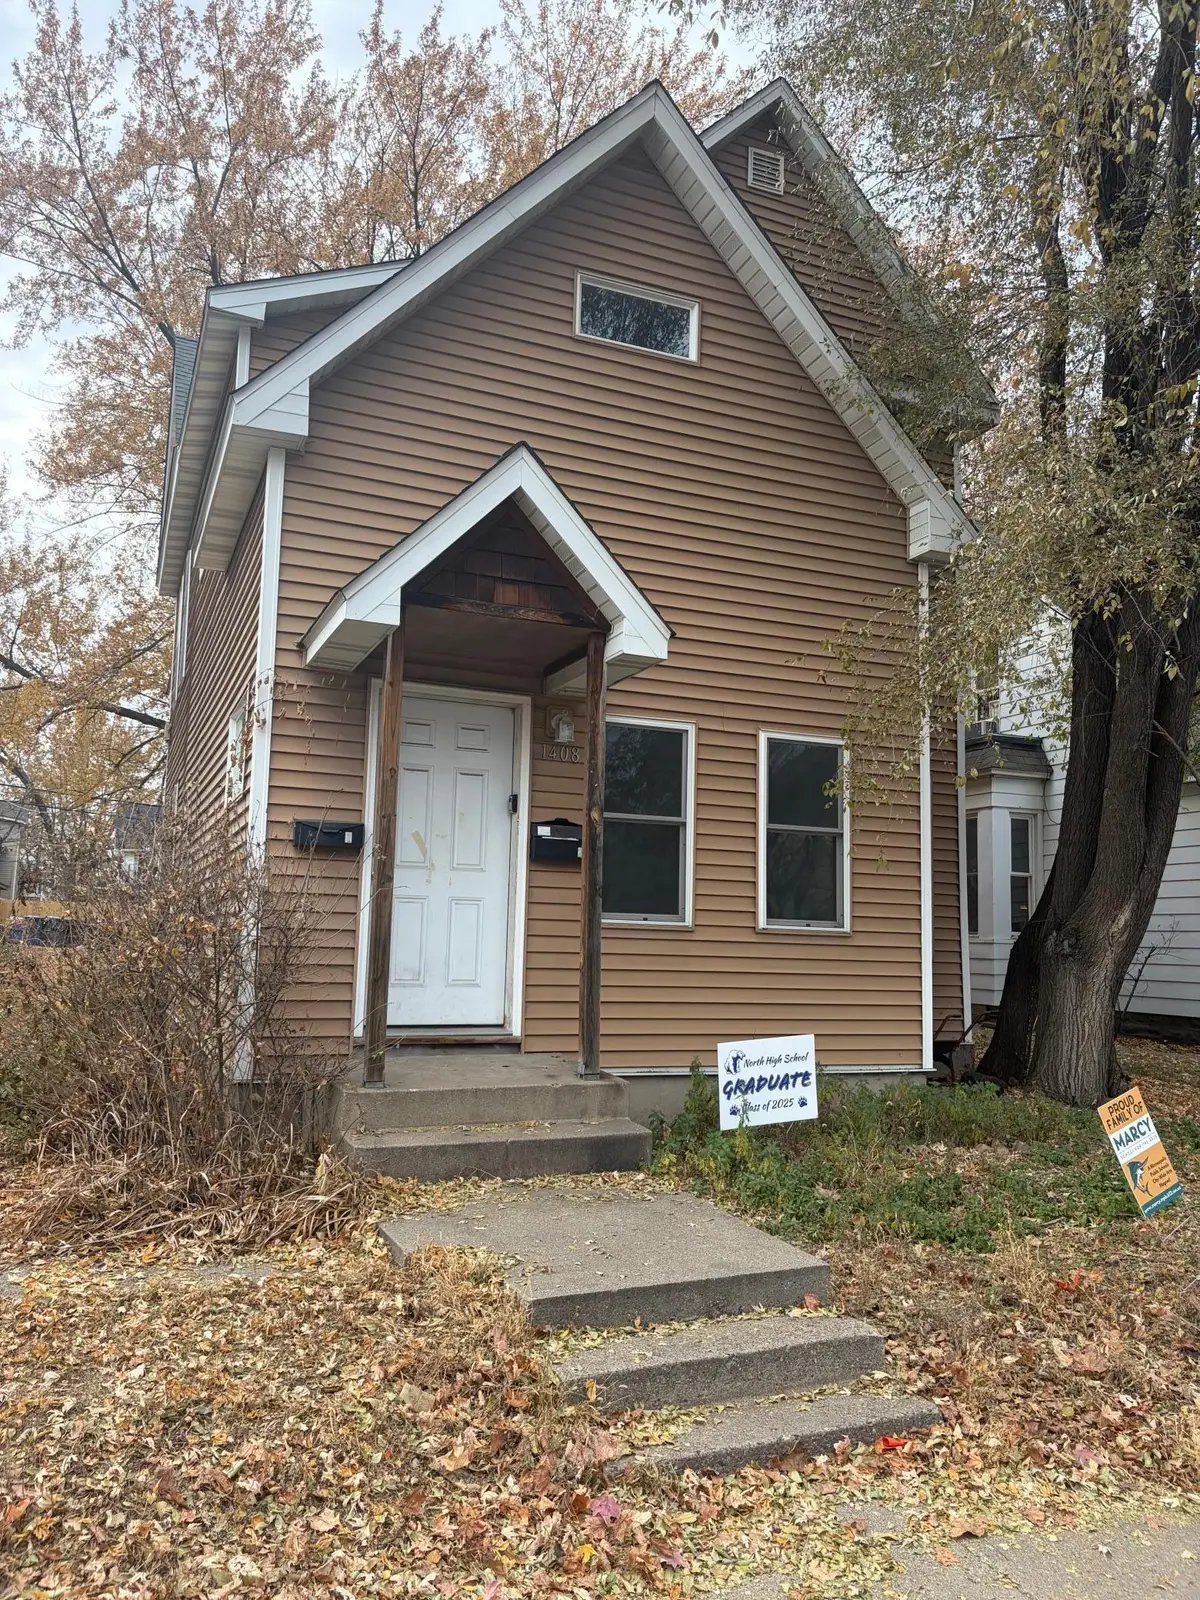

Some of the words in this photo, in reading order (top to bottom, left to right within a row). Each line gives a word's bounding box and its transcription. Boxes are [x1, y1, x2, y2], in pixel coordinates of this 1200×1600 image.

[541, 744, 580, 763] 1408
[743, 1055, 765, 1068] North
[765, 1054, 782, 1068] High
[783, 1051, 809, 1064] School
[722, 1070, 813, 1101] GRADUATE
[762, 1100, 772, 1112] of
[771, 1097, 795, 1110] 2025
[1106, 1107, 1133, 1130] FAMILY
[1133, 1101, 1144, 1115] OF
[1107, 1094, 1135, 1117] PROUD
[1112, 1116, 1152, 1151] MARCY
